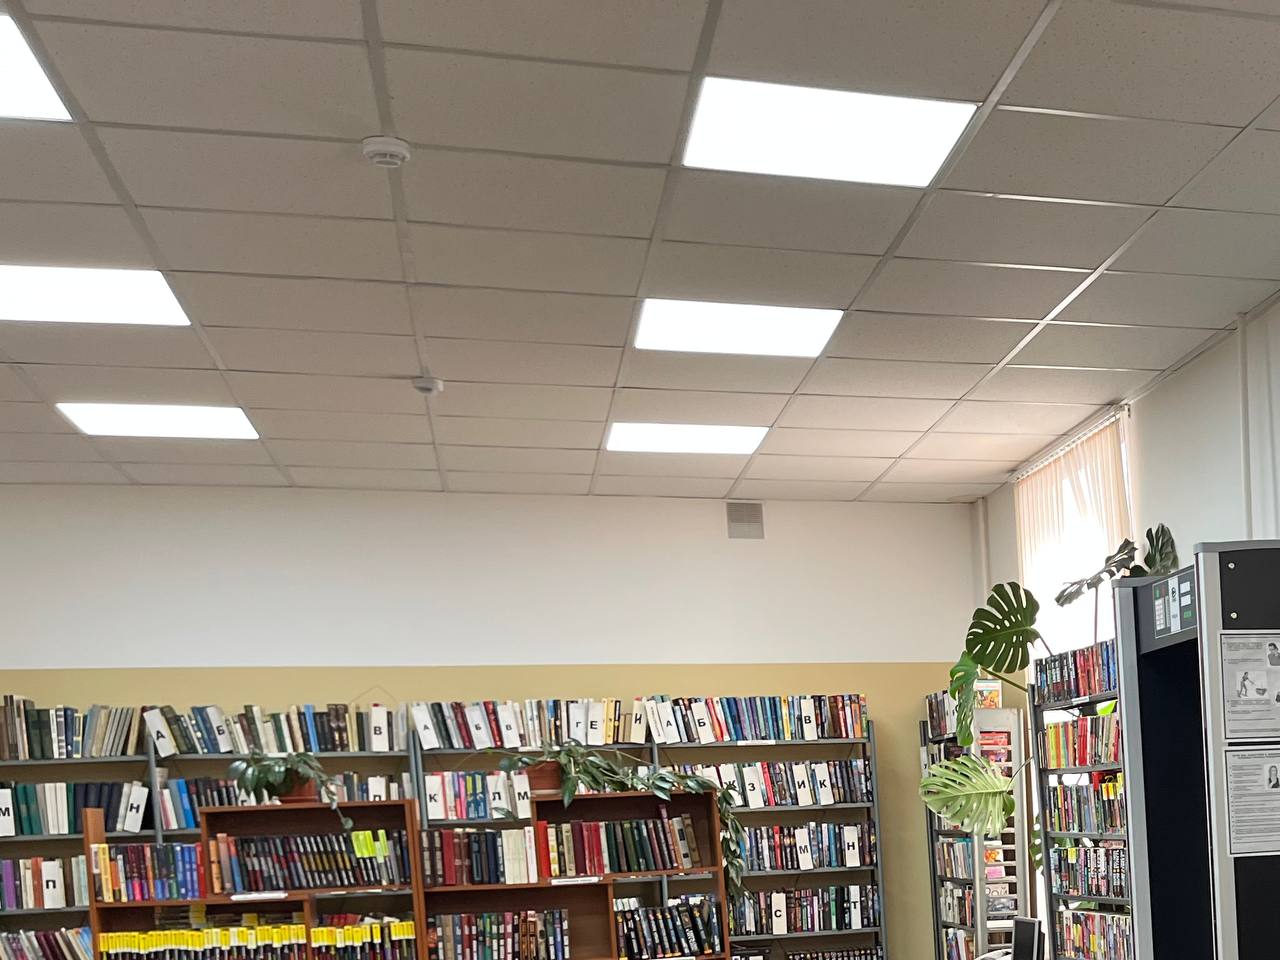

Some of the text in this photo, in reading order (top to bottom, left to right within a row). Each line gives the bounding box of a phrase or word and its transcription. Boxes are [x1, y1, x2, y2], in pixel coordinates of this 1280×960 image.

[590, 720, 597, 729] Е
[698, 718, 706, 727] Б
[804, 716, 812, 724] В
[216, 726, 225, 735] Б
[374, 726, 383, 735] В
[156, 731, 166, 740] А
[748, 783, 755, 791] З
[797, 780, 806, 789] И
[819, 780, 827, 789] К
[429, 793, 437, 802] К
[518, 791, 529, 800] М
[129, 803, 139, 813] Н
[799, 845, 809, 854] М
[847, 841, 855, 850] Н
[46, 880, 56, 889] П
[774, 909, 782, 918] С
